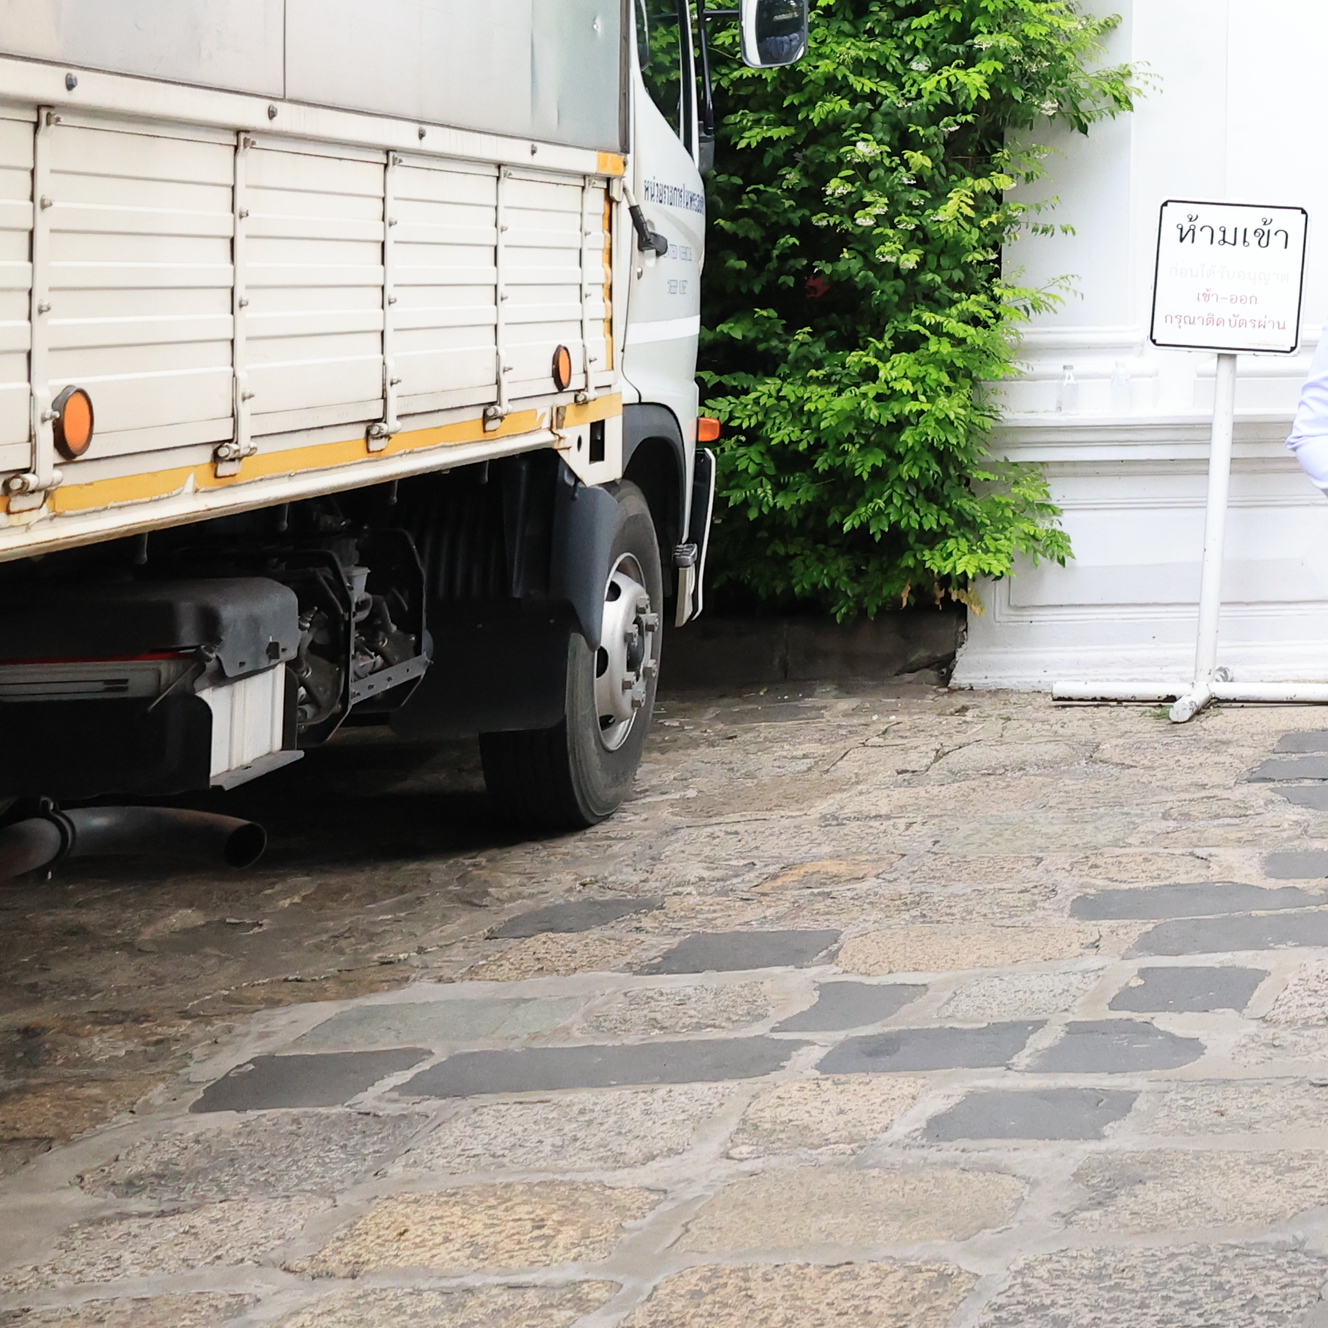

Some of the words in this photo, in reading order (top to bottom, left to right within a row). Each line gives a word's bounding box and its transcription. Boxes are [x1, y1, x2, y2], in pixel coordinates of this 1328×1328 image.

[1176, 213, 1289, 250] ห้ามเข้า
[1169, 263, 1290, 286] ก่อนได้รับอนุญาต
[1196, 287, 1258, 306] เข้า-ออก
